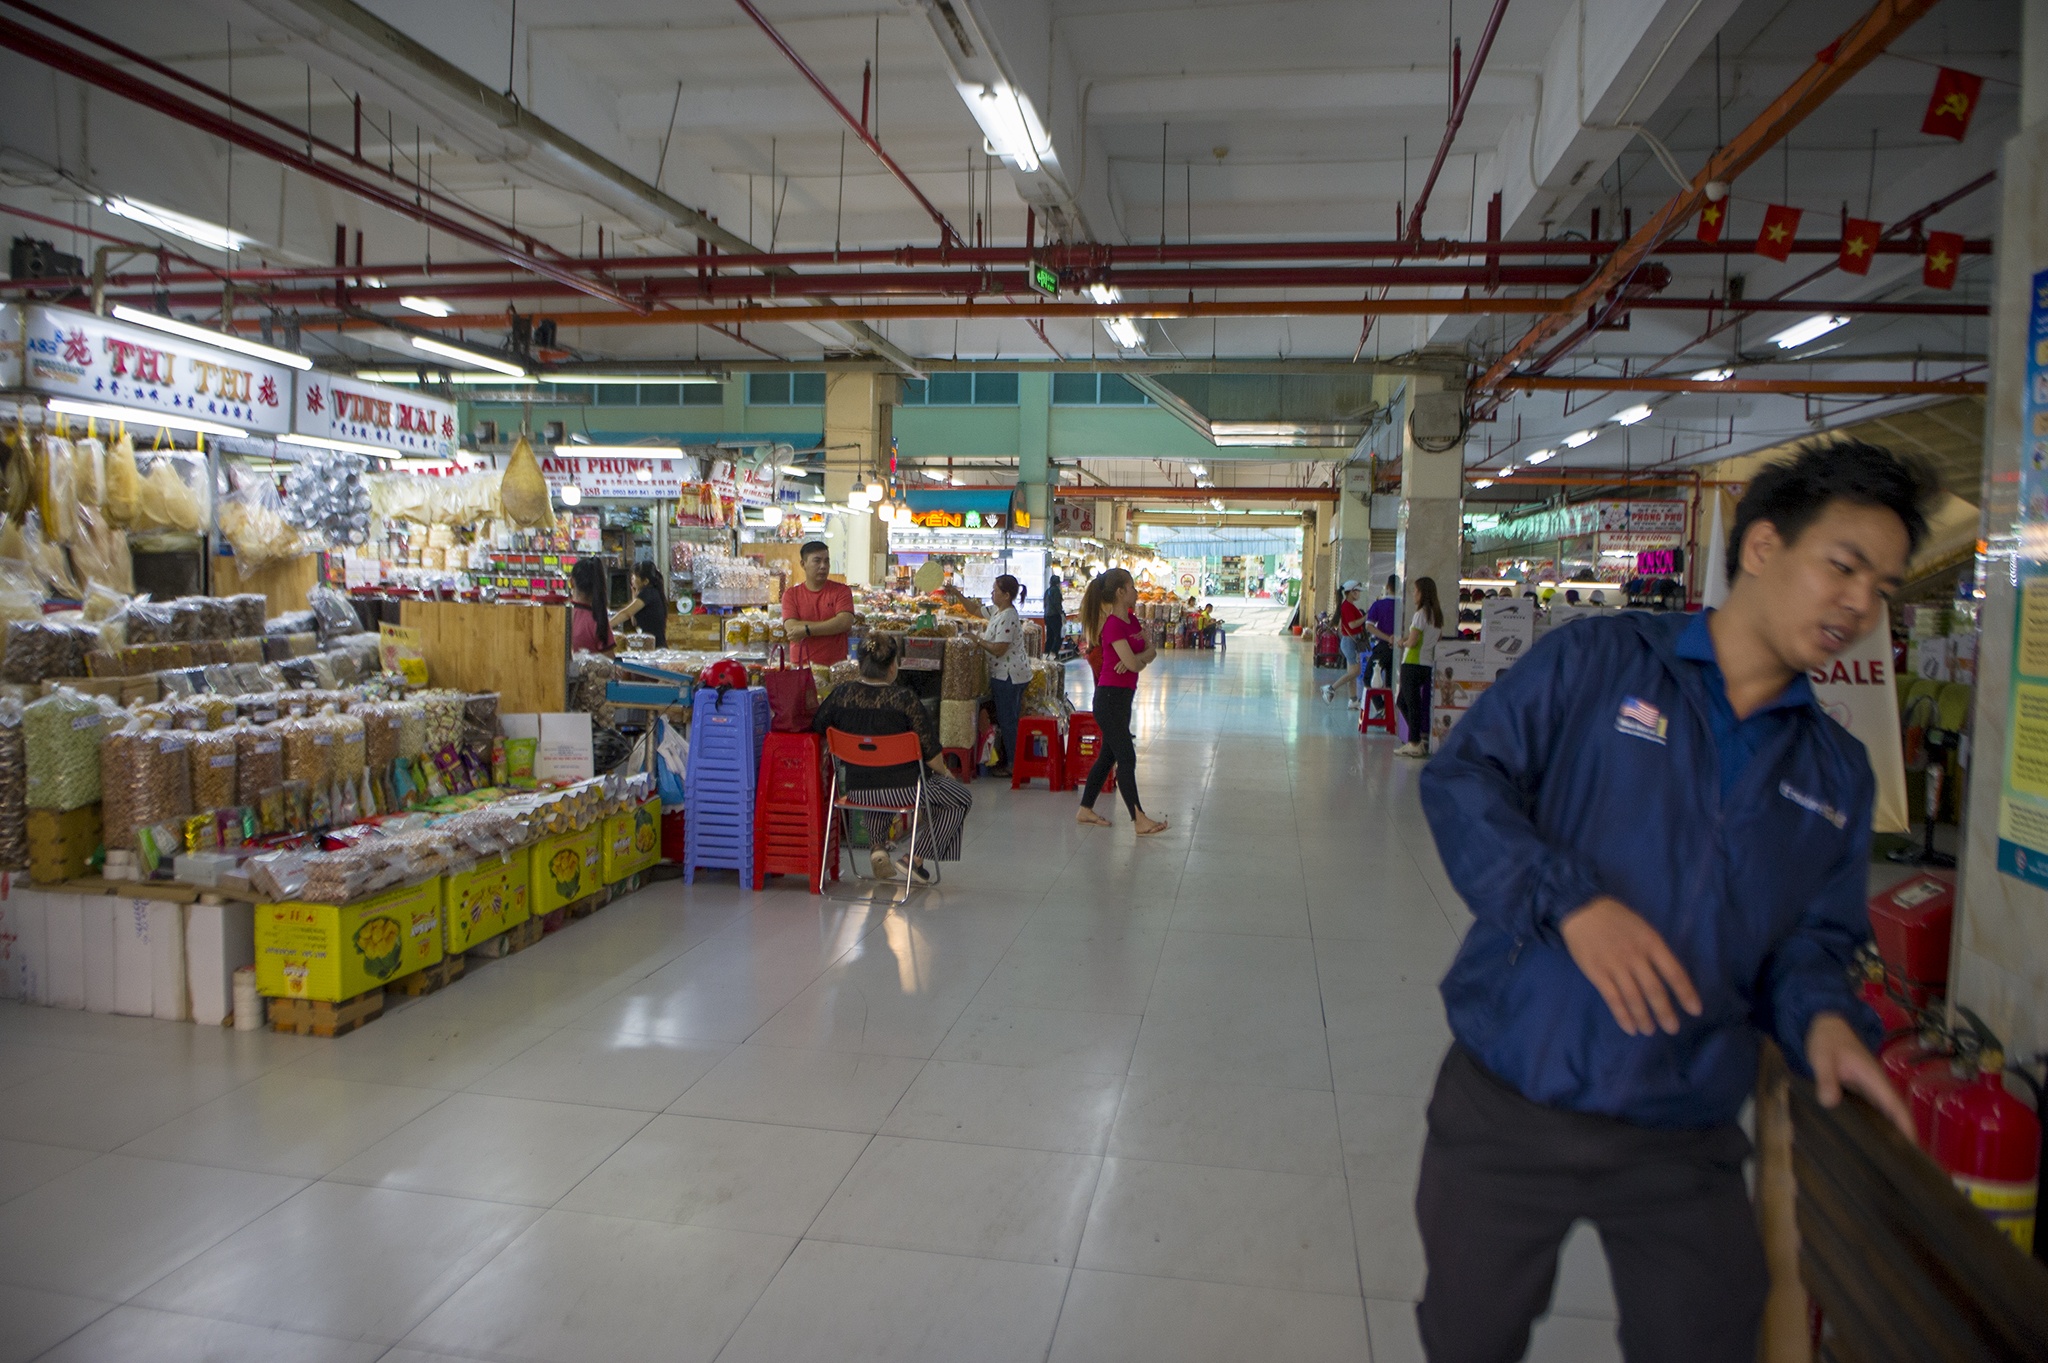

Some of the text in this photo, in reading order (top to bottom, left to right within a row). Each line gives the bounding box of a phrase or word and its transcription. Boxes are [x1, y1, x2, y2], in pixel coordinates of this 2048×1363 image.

[104, 336, 176, 386] THI
[191, 359, 254, 403] THI
[1631, 513, 1661, 522] PHONG
[1810, 660, 1885, 686] SALE
